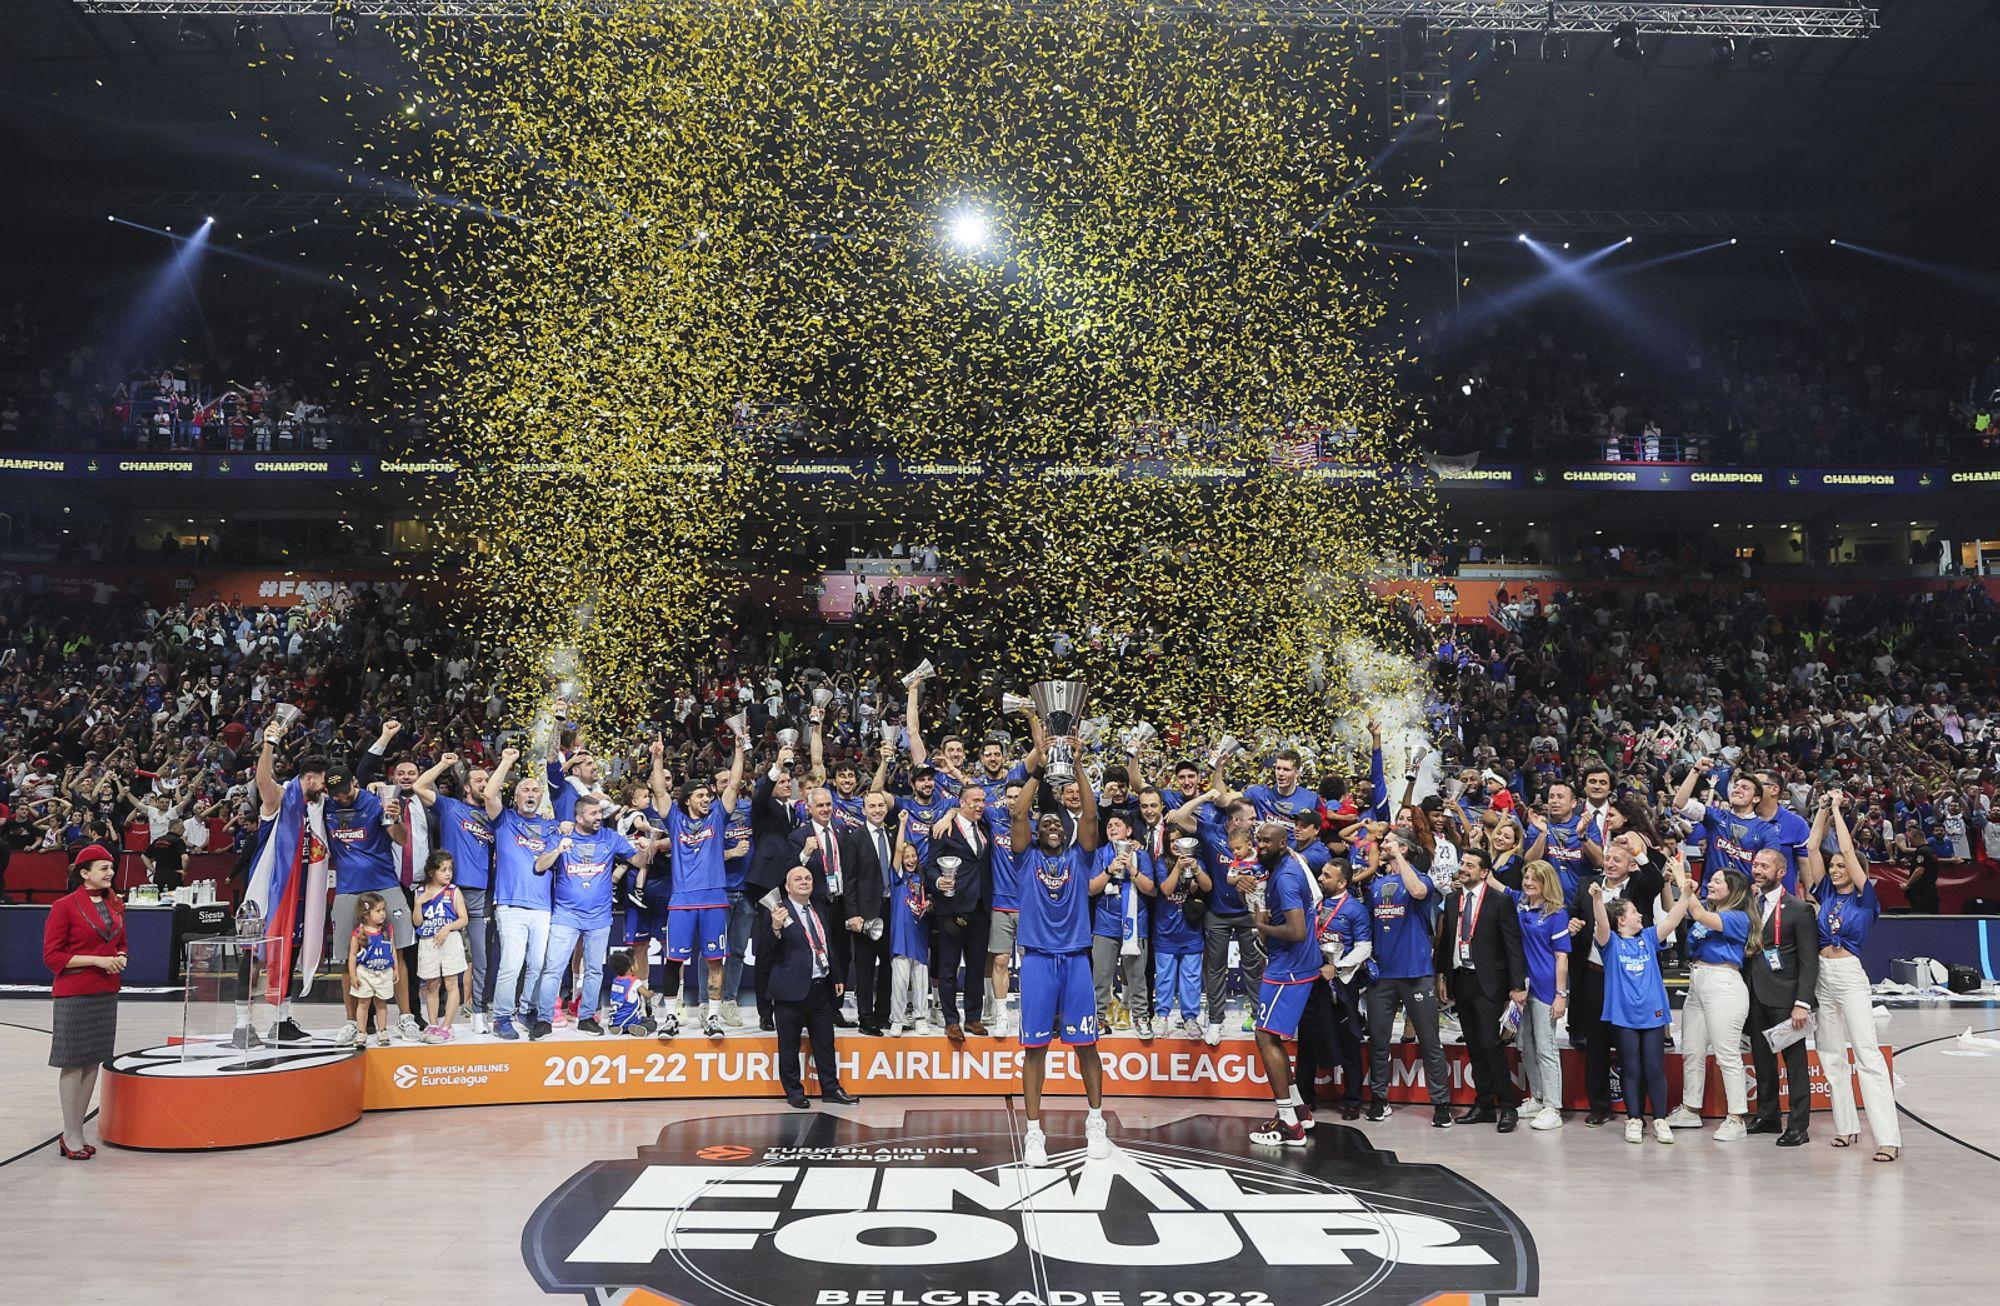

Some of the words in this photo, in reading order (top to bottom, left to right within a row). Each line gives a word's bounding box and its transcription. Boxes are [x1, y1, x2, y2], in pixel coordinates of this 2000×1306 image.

[119, 462, 194, 471] CHAMPION
[255, 462, 328, 472] CHAMPION
[775, 465, 851, 474] CHAMPION
[907, 465, 984, 475] CHAMPION
[1563, 471, 1637, 481] CHAMPION
[1690, 472, 1763, 483] CHAMPION
[1823, 474, 1895, 485] CHAMPION
[1439, 845, 1451, 859] 23
[198, 911, 225, 920] Siesta
[424, 902, 446, 919] 44
[1080, 1015, 1094, 1035] 42
[422, 1066, 465, 1075] TURKISH
[467, 1063, 510, 1073] AIRLINES
[543, 1053, 687, 1087] 2021-22
[1045, 1051, 1297, 1084] EUROLEAGU
[421, 1074, 488, 1087] EuroLeague
[767, 1147, 868, 1155] TURKISH
[762, 1153, 927, 1163] EuroLeague
[613, 1166, 1368, 1211] FINAL
[564, 1209, 1500, 1266] FOUR
[815, 1289, 1133, 1306] BELGRADE
[1139, 1290, 1275, 1306] 2022
